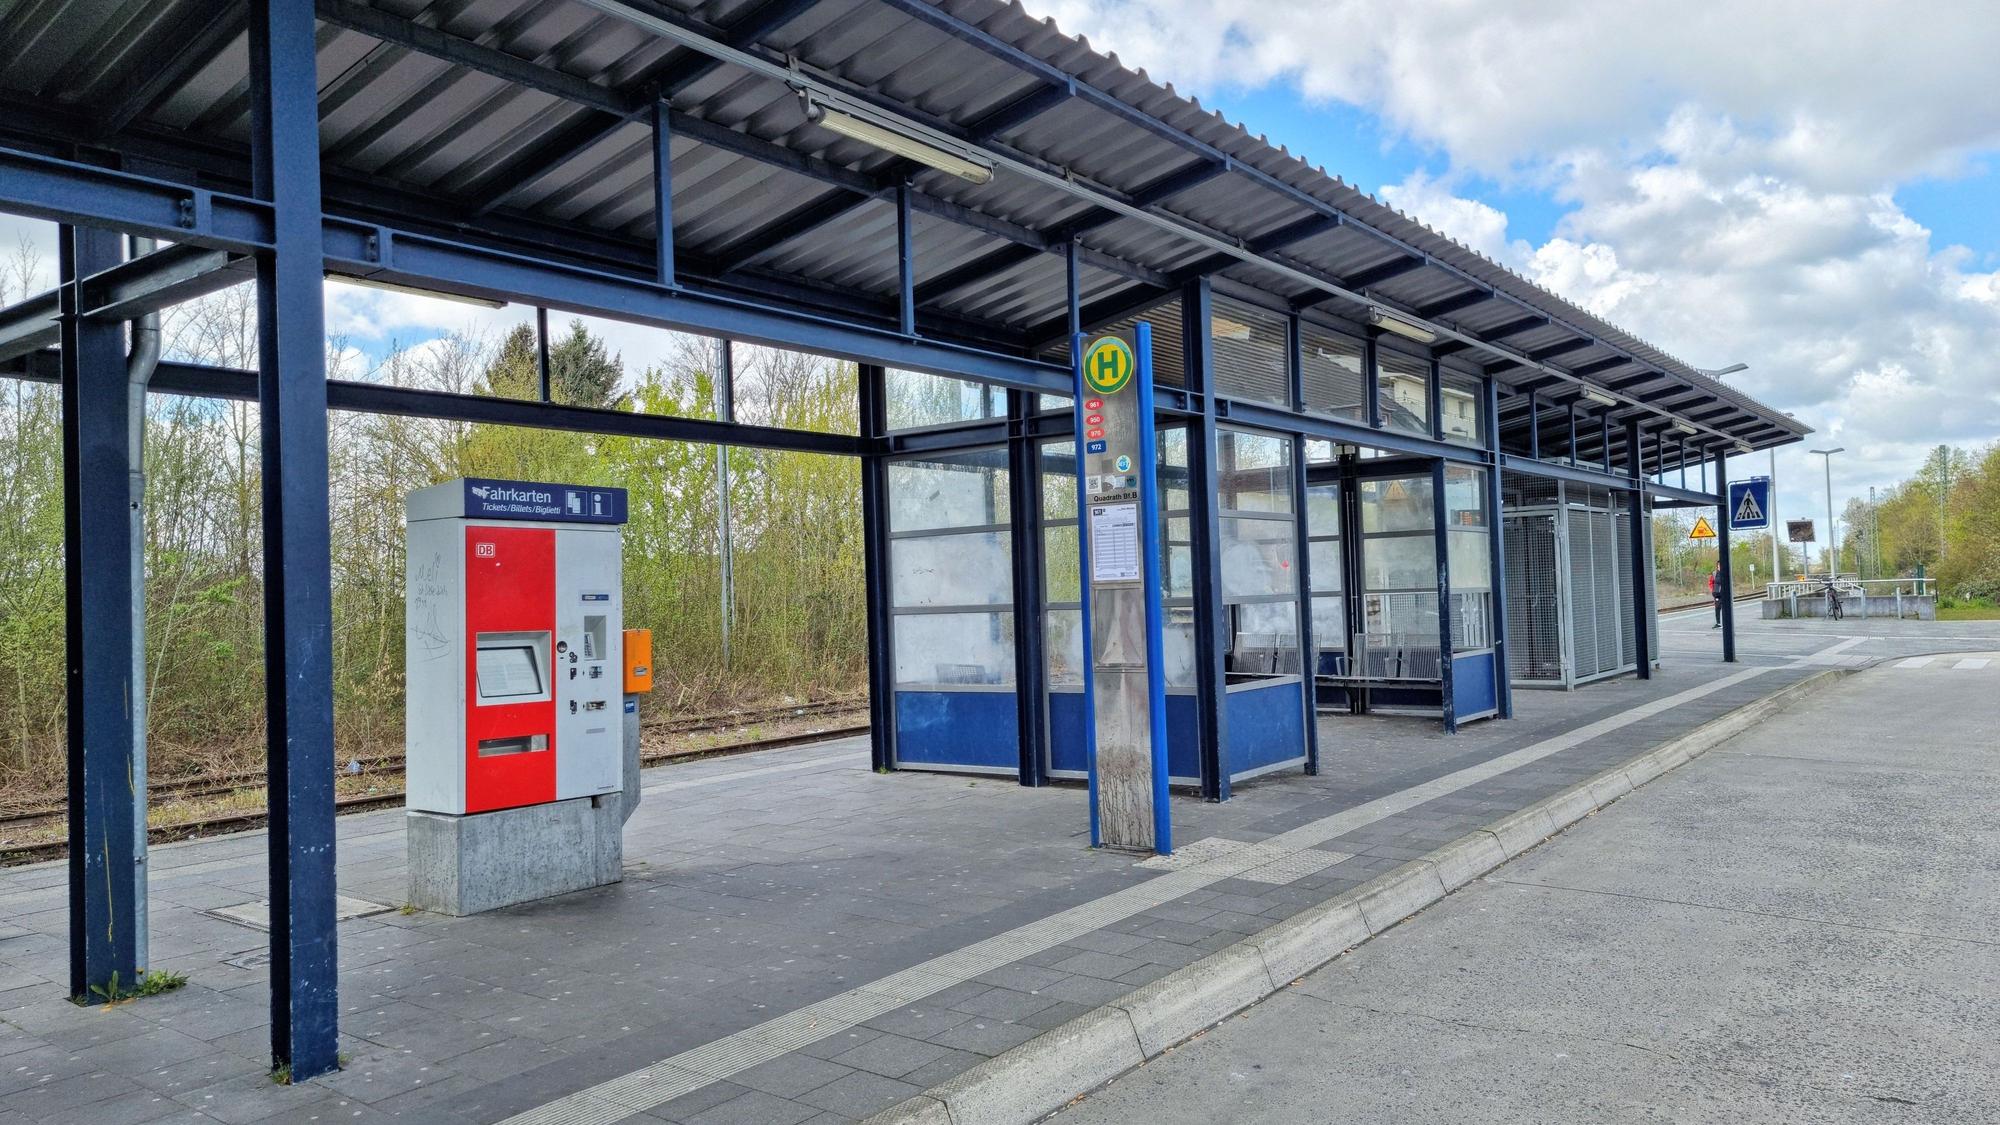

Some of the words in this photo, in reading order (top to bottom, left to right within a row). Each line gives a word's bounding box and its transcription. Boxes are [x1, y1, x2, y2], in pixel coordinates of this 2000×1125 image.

[1098, 350, 1119, 380] H
[1091, 443, 1102, 451] 972
[482, 486, 552, 504] Fahrkarten
[1093, 494, 1122, 502] Quadrath
[478, 545, 493, 556] DB
